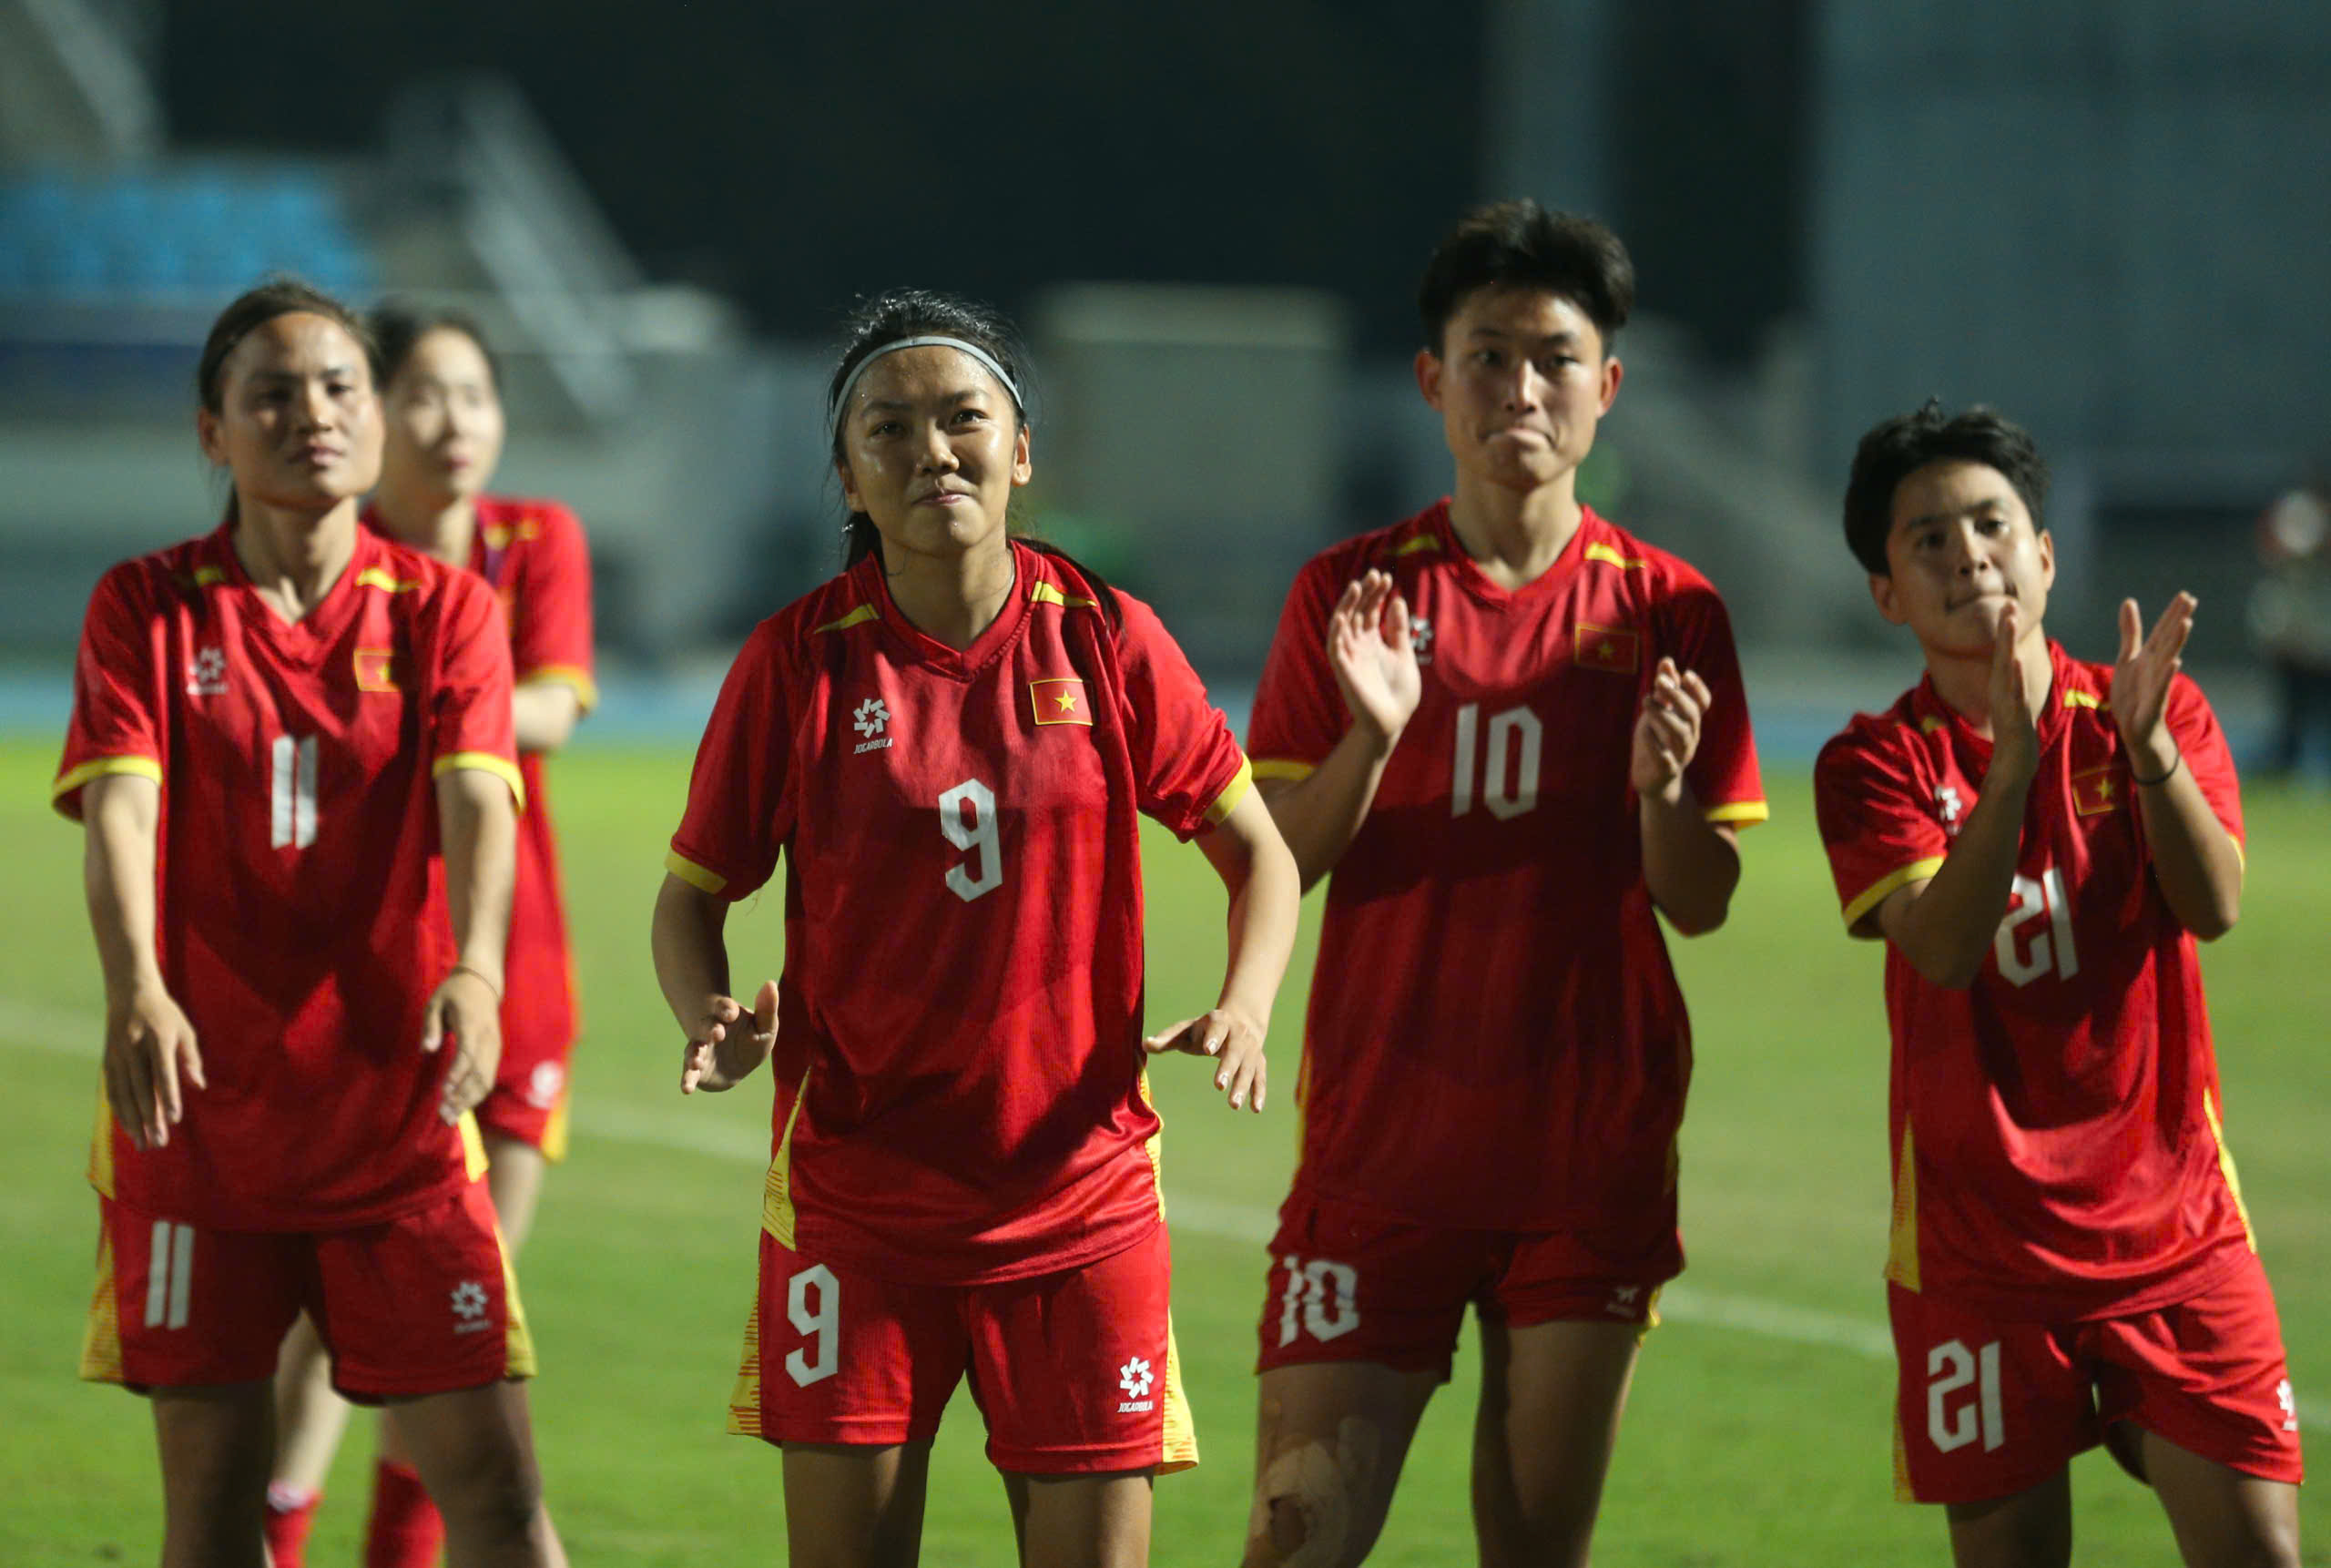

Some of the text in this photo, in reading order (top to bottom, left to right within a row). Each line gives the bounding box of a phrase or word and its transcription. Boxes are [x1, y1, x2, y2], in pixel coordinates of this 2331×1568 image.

[271, 735, 318, 850] 11
[1452, 703, 1542, 820] 10
[939, 779, 1003, 902] 9
[1995, 867, 2078, 988] 21
[145, 1220, 195, 1329] 11
[786, 1264, 840, 1389] 9
[1279, 1256, 1359, 1348] 10
[1928, 1339, 2005, 1454] 21
